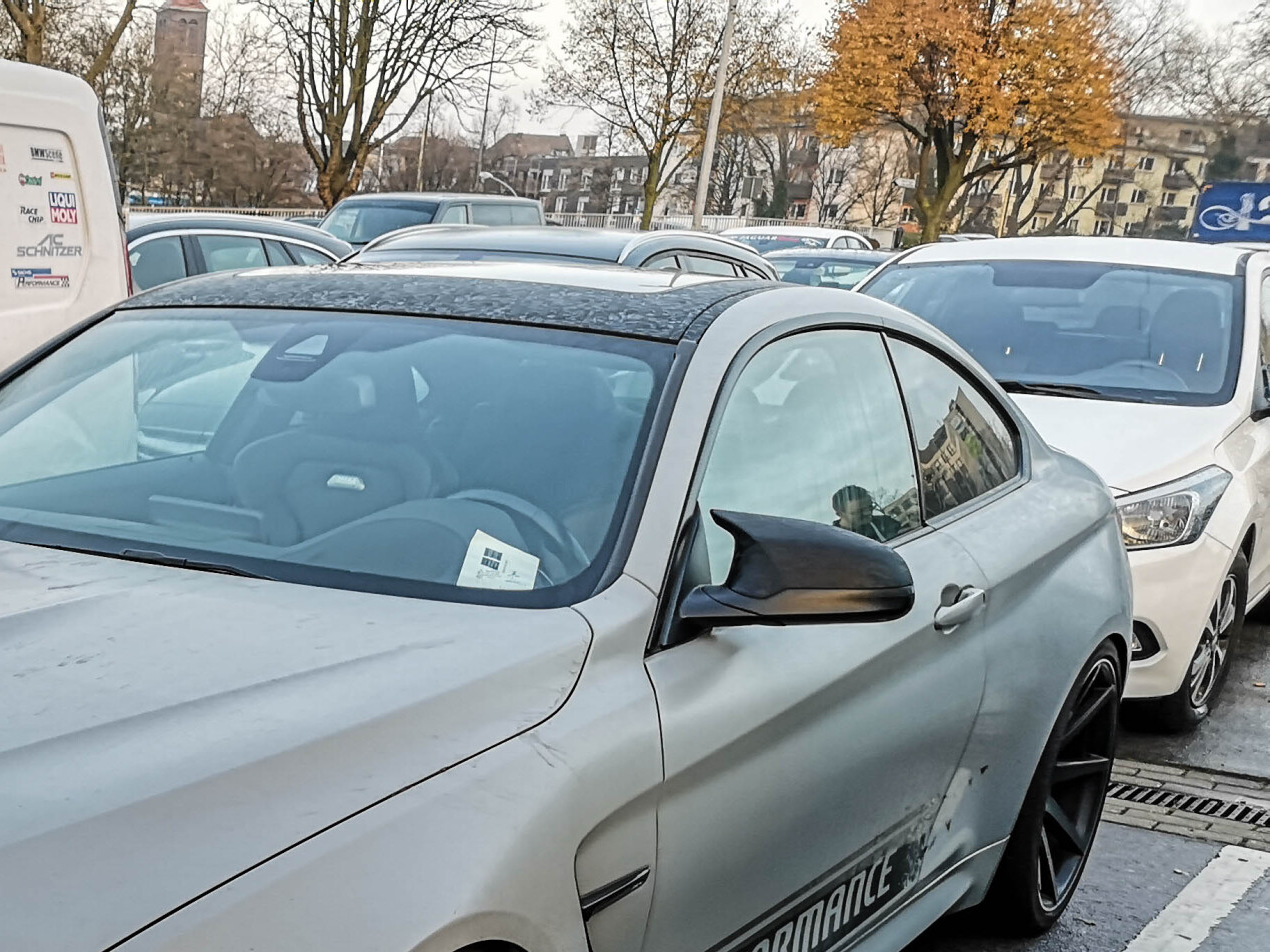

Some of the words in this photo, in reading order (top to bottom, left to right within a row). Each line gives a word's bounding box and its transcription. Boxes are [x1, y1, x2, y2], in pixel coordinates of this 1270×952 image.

[49, 192, 76, 208] LIQUI
[20, 206, 38, 215] RACE
[51, 208, 77, 223] MOLY
[17, 246, 82, 257] SCHNITZER
